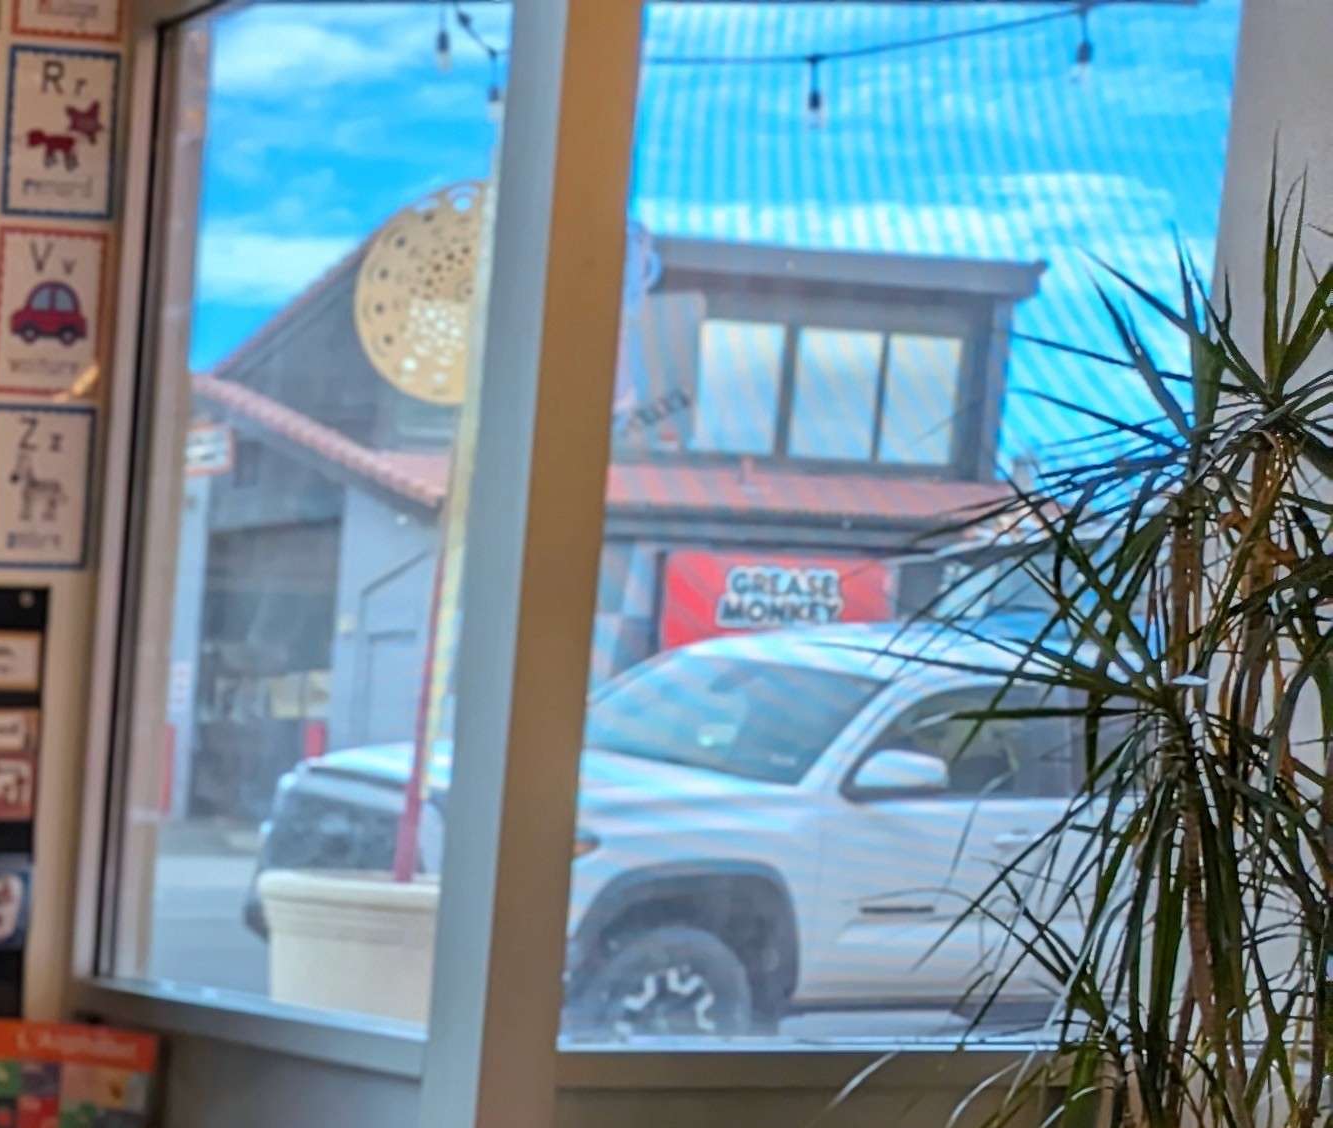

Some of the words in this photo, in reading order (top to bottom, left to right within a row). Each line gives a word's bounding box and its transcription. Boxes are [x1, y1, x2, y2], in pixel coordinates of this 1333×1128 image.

[41, 60, 65, 94] R
[74, 78, 88, 96] r
[29, 241, 54, 273] V
[20, 416, 39, 451] Z
[731, 572, 835, 599] GREASE
[719, 601, 841, 623] MONKEY
